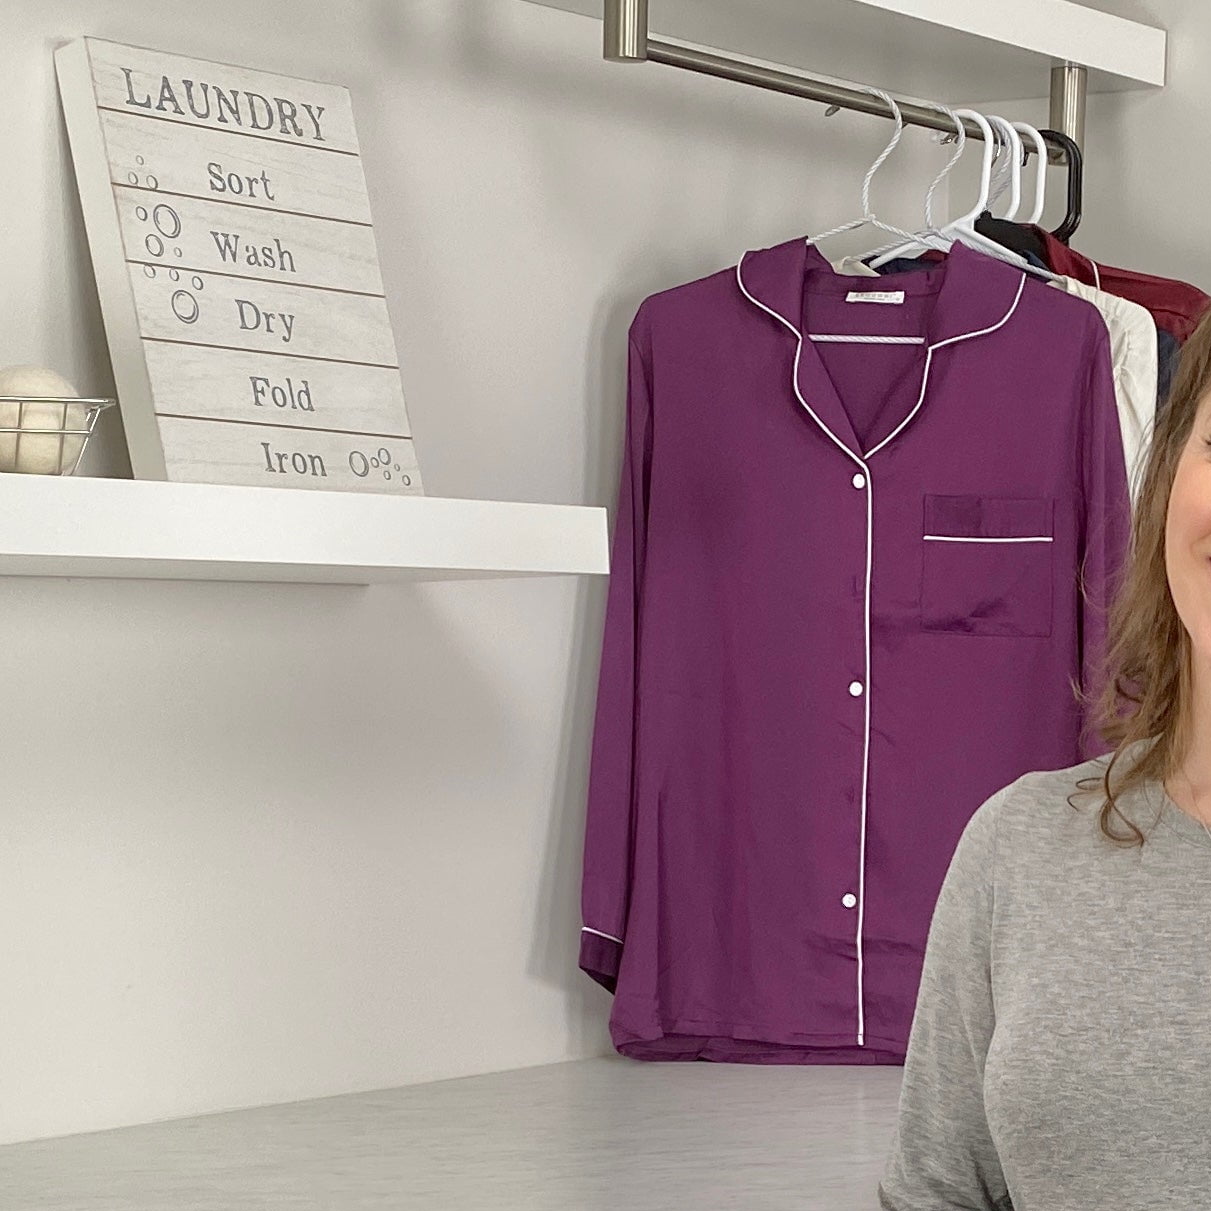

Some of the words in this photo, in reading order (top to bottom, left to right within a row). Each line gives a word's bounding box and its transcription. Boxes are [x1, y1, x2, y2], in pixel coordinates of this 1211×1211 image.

[120, 68, 326, 141] LAUNDRY
[207, 161, 276, 201] Sort
[210, 230, 297, 273] Wash
[234, 299, 297, 341] Dry
[249, 376, 316, 412] Fold
[263, 442, 327, 478] Iron
